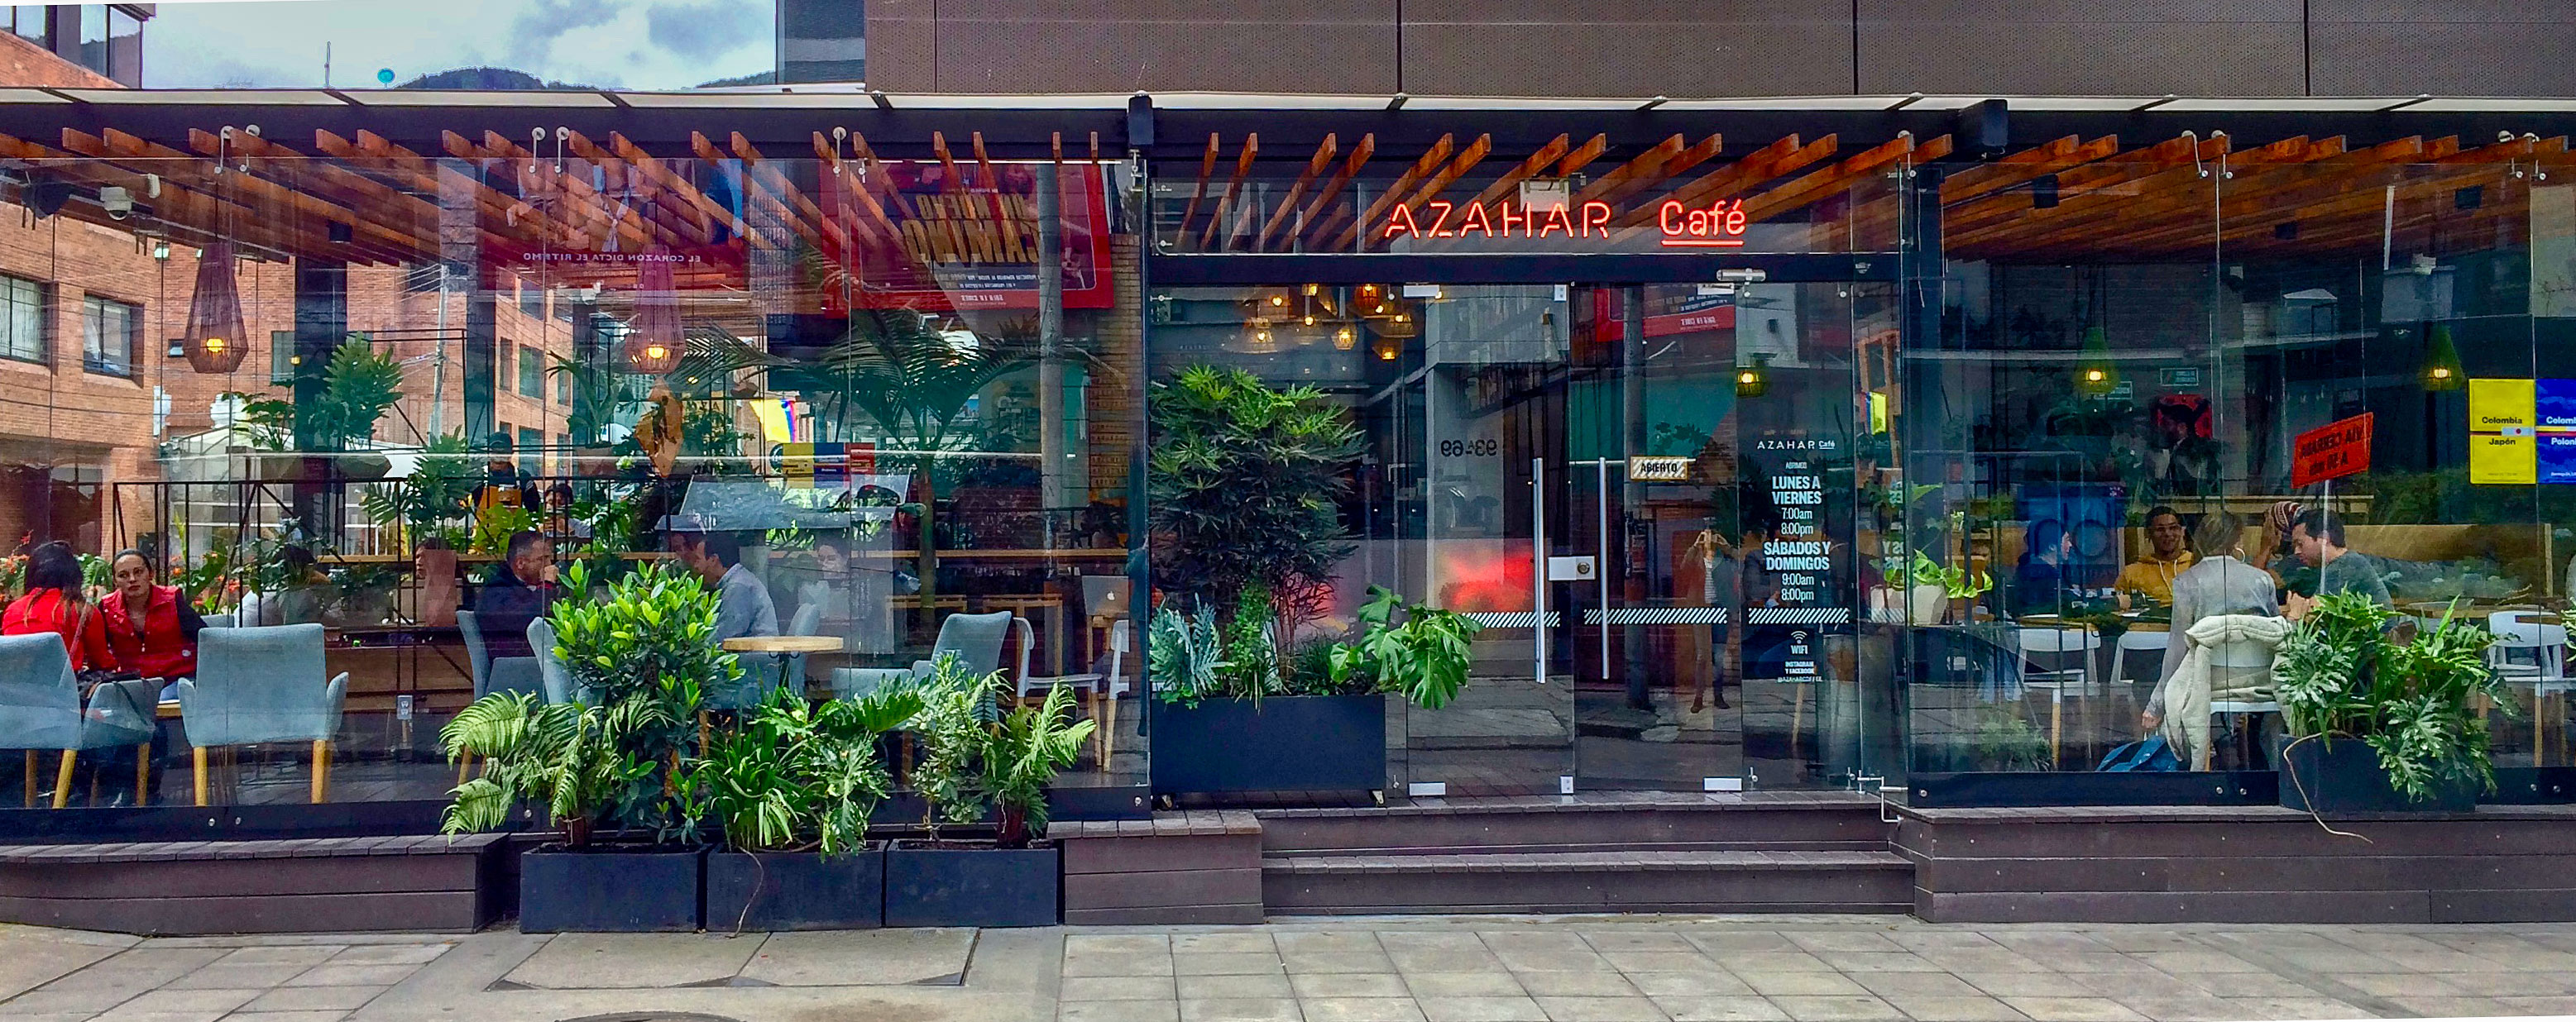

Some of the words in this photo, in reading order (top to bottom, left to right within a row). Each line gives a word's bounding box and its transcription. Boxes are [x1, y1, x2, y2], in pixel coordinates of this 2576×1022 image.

[1383, 200, 1611, 239] AZAHAR
[1659, 198, 1746, 237] Café
[1757, 441, 1815, 449] AZAHAR
[1640, 463, 1678, 472] ABIERTO
[1772, 475, 1810, 490] LUNES
[1812, 475, 1821, 490] A
[1771, 491, 1822, 504] VIERNES
[1781, 507, 1812, 520] 7:00am
[1781, 522, 1813, 537] 8:00pm
[1764, 538, 1820, 556] SÁBADOS
[1822, 542, 1831, 555] Y
[1765, 556, 1830, 571] DOMINGOS
[1781, 573, 1815, 586] 9:00am
[1781, 588, 1815, 604] 8:00pm
[1790, 644, 1808, 655] WIFI
